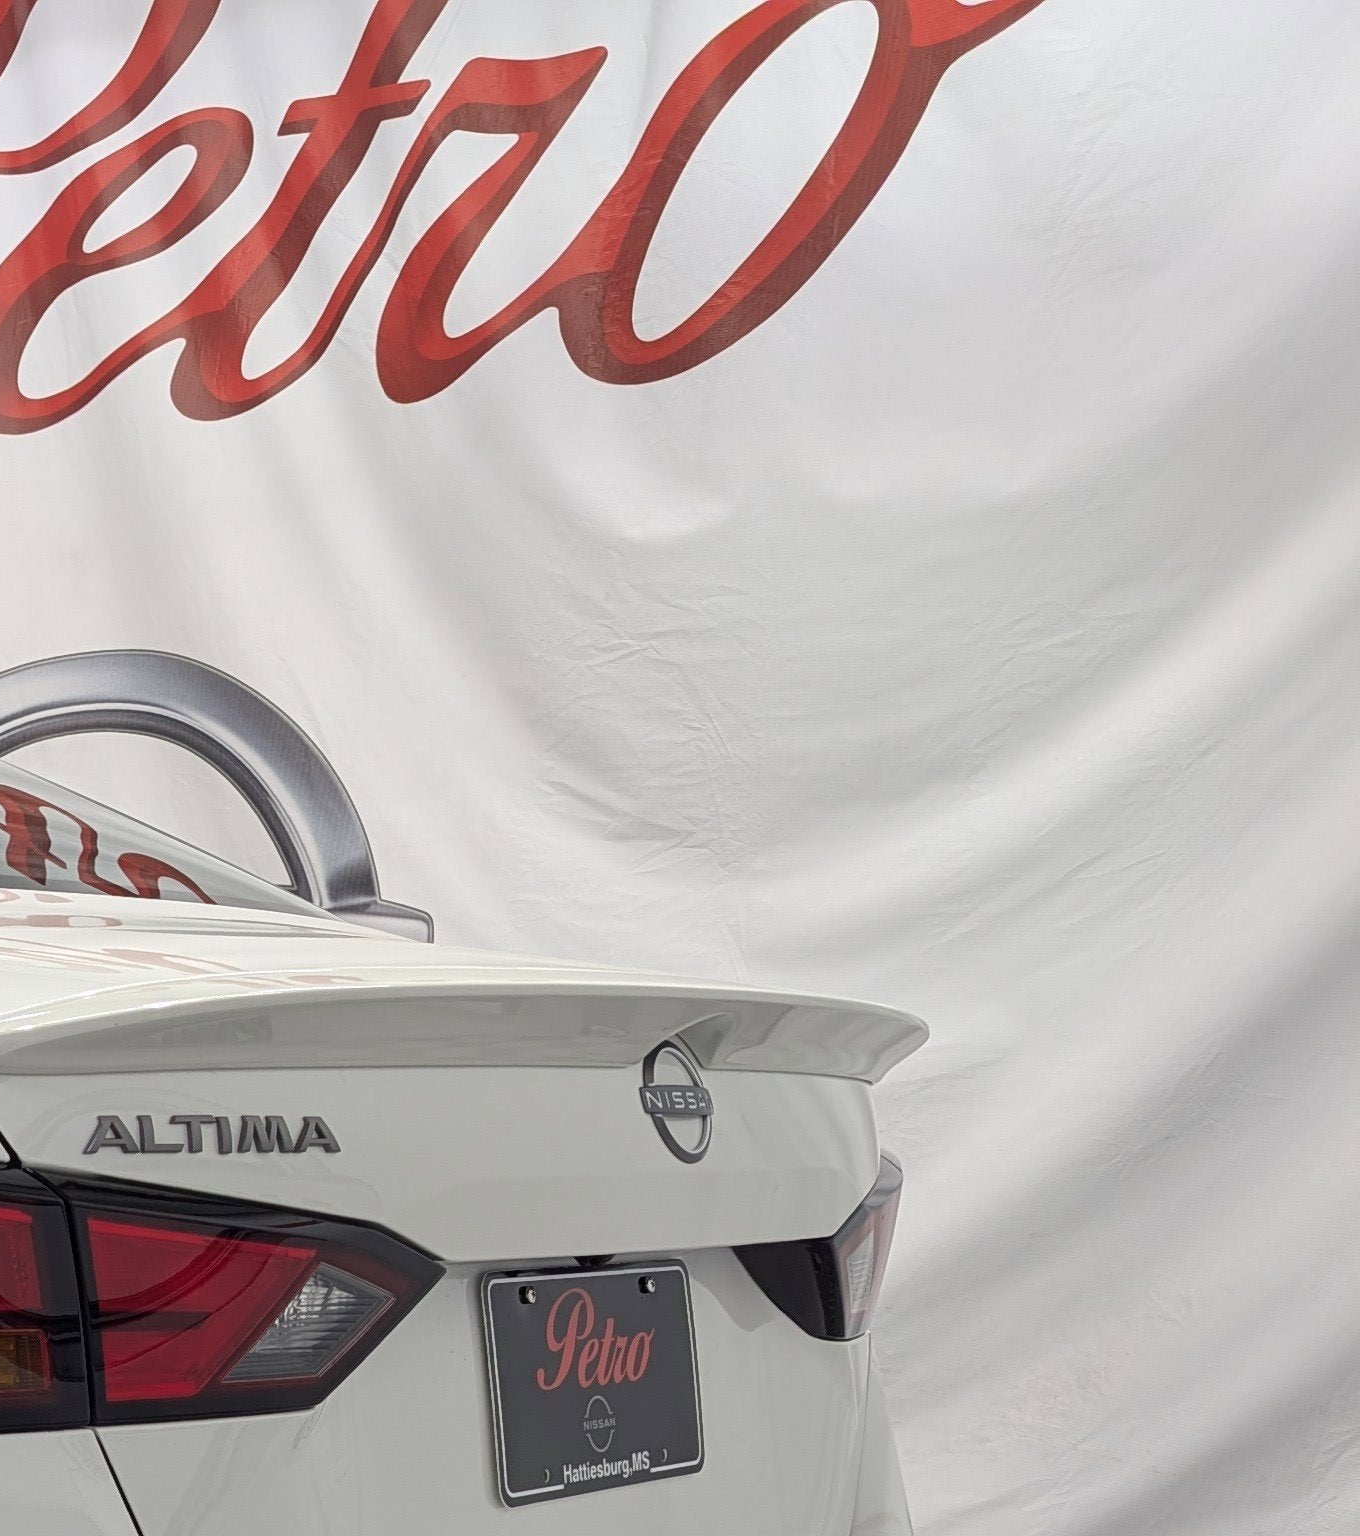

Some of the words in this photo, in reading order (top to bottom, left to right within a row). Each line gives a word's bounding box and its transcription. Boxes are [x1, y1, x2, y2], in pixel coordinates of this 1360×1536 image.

[82, 1114, 342, 1155] ALTIMA
[536, 1287, 656, 1391] Petro
[583, 1417, 616, 1431] NISSAN
